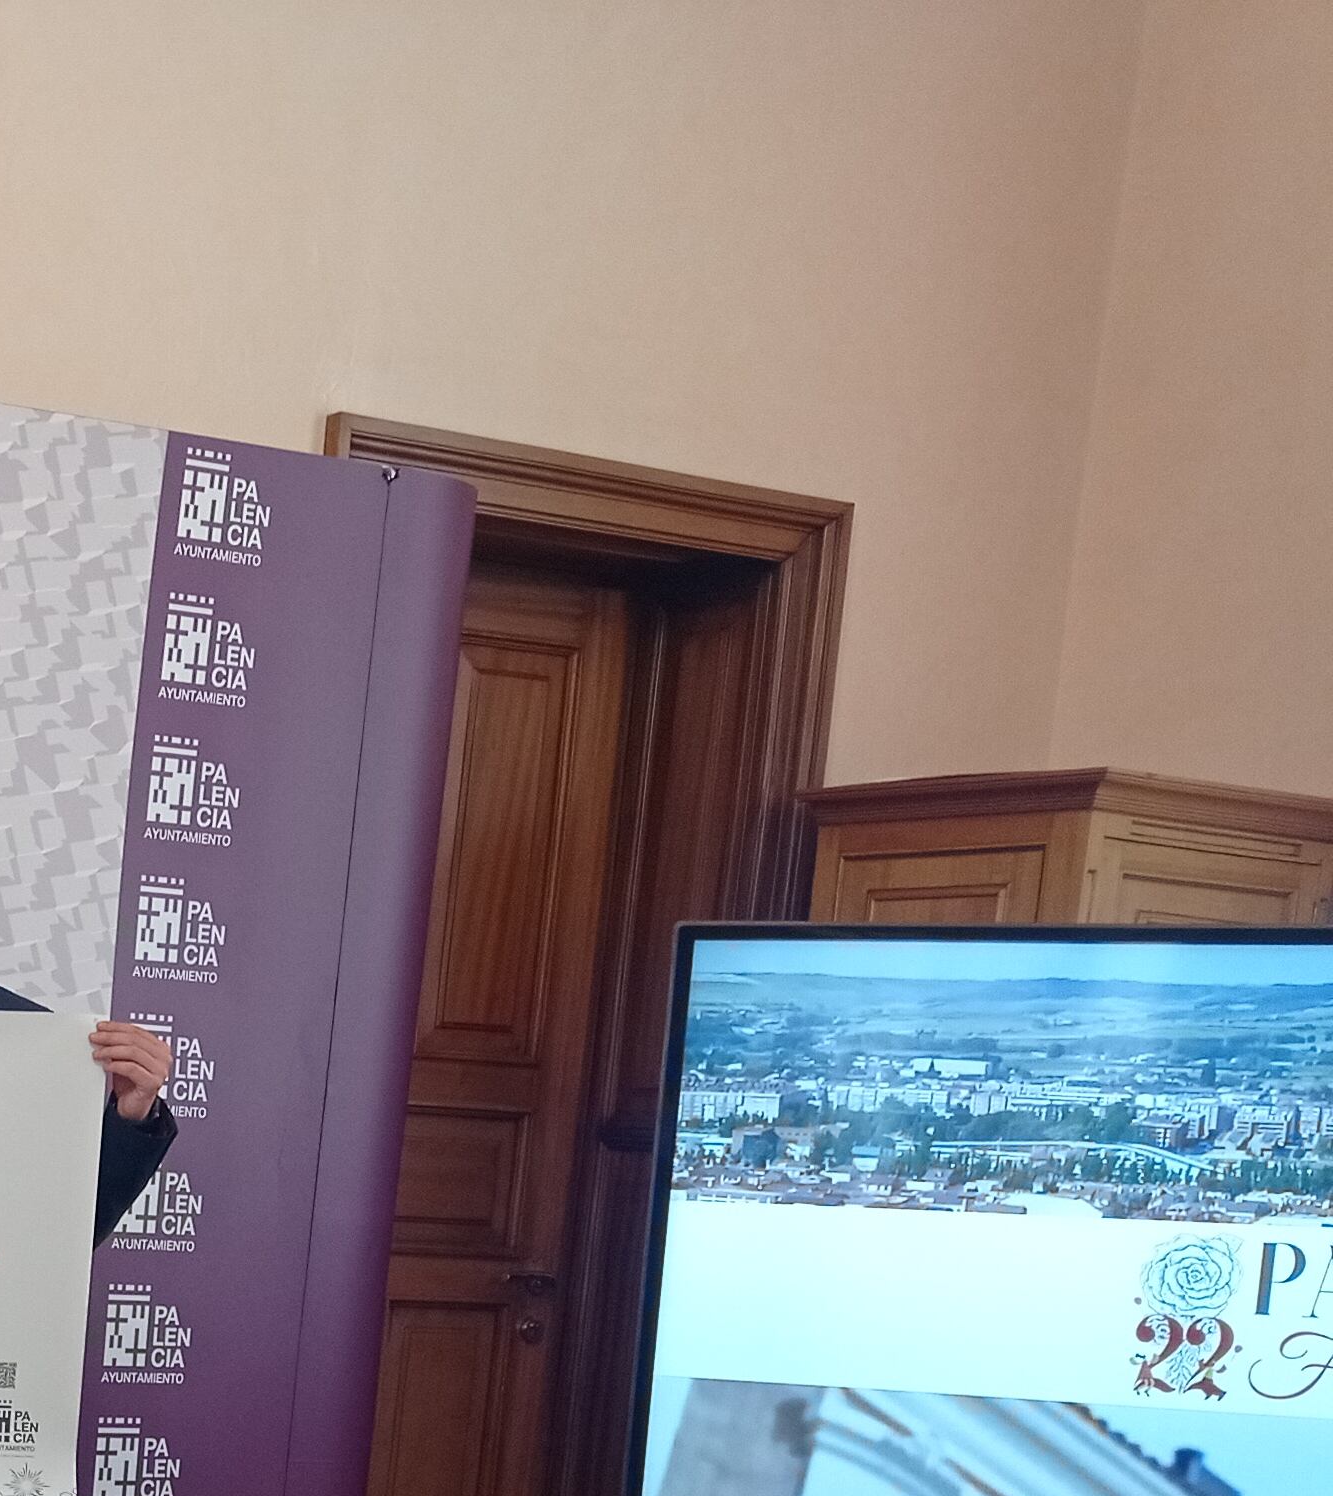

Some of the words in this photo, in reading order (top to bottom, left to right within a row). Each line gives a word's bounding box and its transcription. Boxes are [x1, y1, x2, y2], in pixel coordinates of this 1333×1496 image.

[233, 477, 258, 503] PA
[229, 501, 271, 528] LEN
[226, 525, 263, 550] CIA
[174, 542, 261, 567] AYUNTAMIENTO
[187, 900, 214, 922] PA
[185, 922, 226, 946] LEN
[183, 944, 219, 967] CIA
[133, 965, 218, 985] AYUNTAMIENTO
[155, 1305, 180, 1326] PA
[152, 1326, 192, 1348] LEN
[150, 1347, 185, 1369] CIA
[1133, 1314, 1234, 1401] 22
[101, 1371, 184, 1385] AYUNTAMIENTO
[14, 1411, 31, 1422] PA
[14, 1421, 39, 1433] LEN
[13, 1433, 36, 1444] CIA
